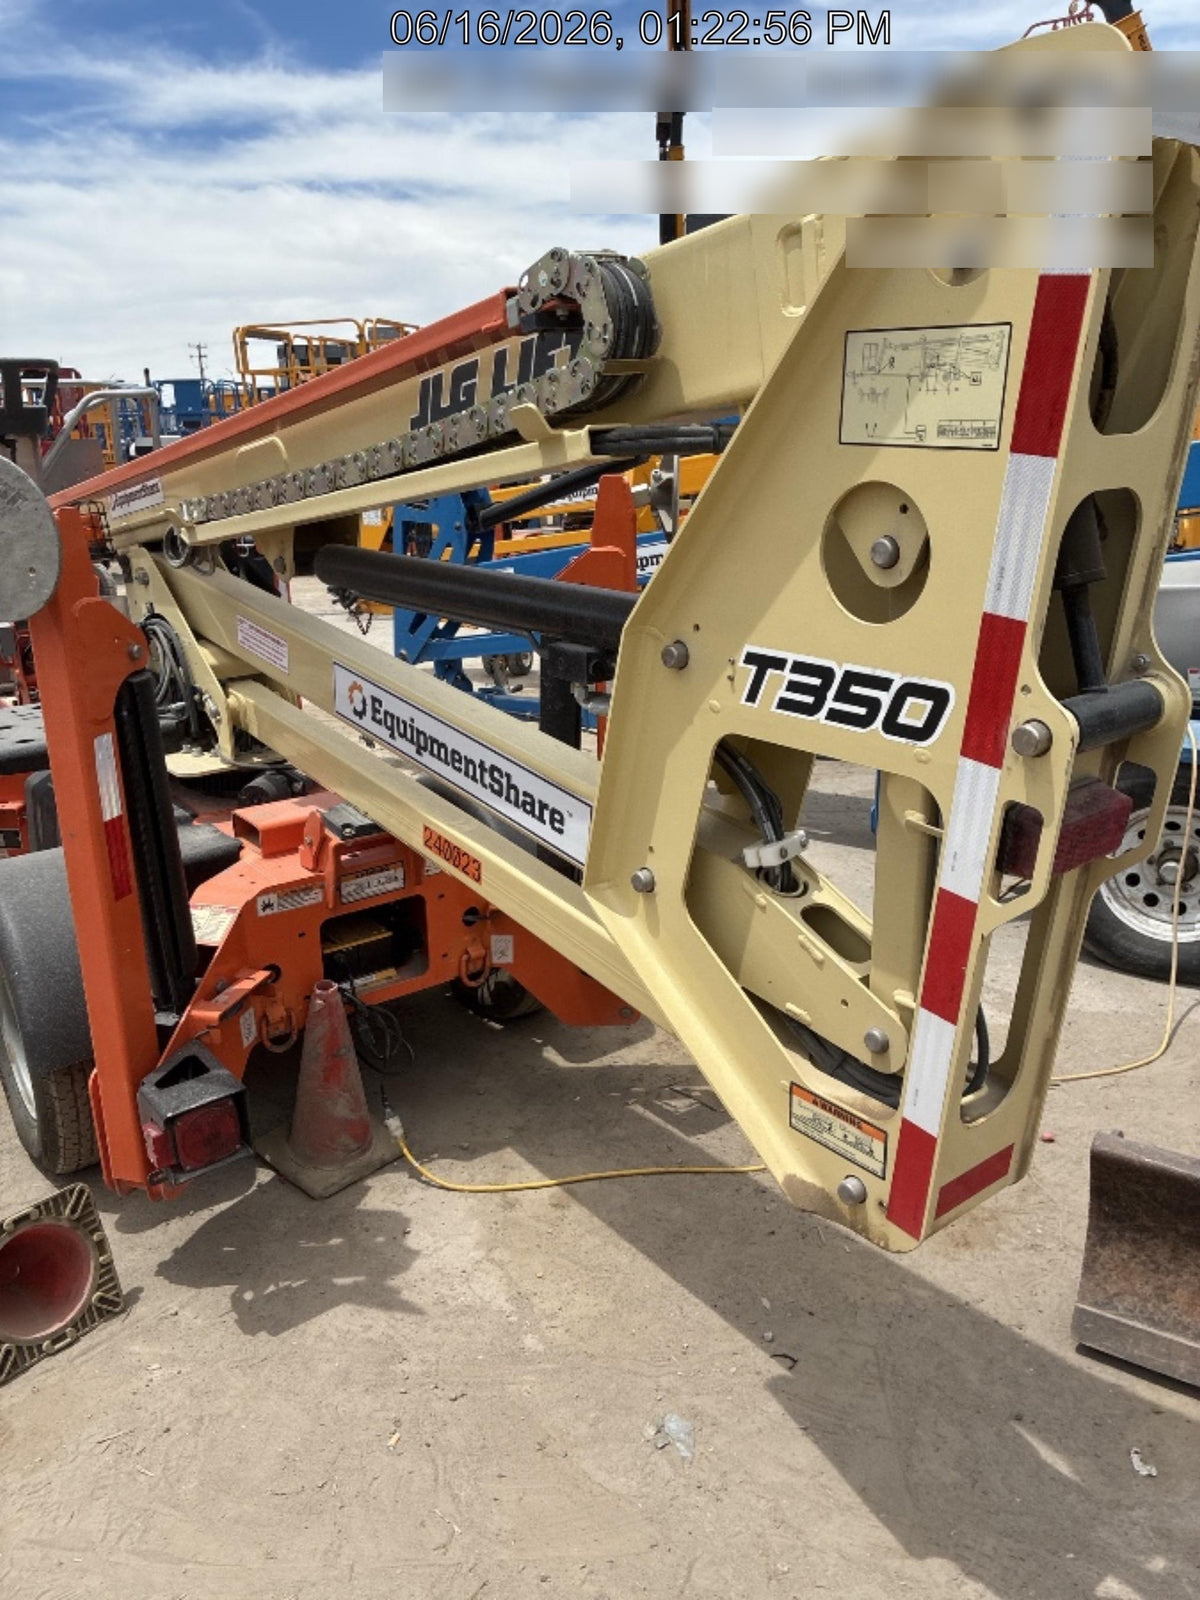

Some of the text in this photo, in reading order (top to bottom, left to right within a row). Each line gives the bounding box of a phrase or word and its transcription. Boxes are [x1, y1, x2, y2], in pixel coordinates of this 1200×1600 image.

[410, 357, 480, 431] JLG
[741, 649, 952, 744] T350
[370, 695, 565, 835] EquipmentShare
